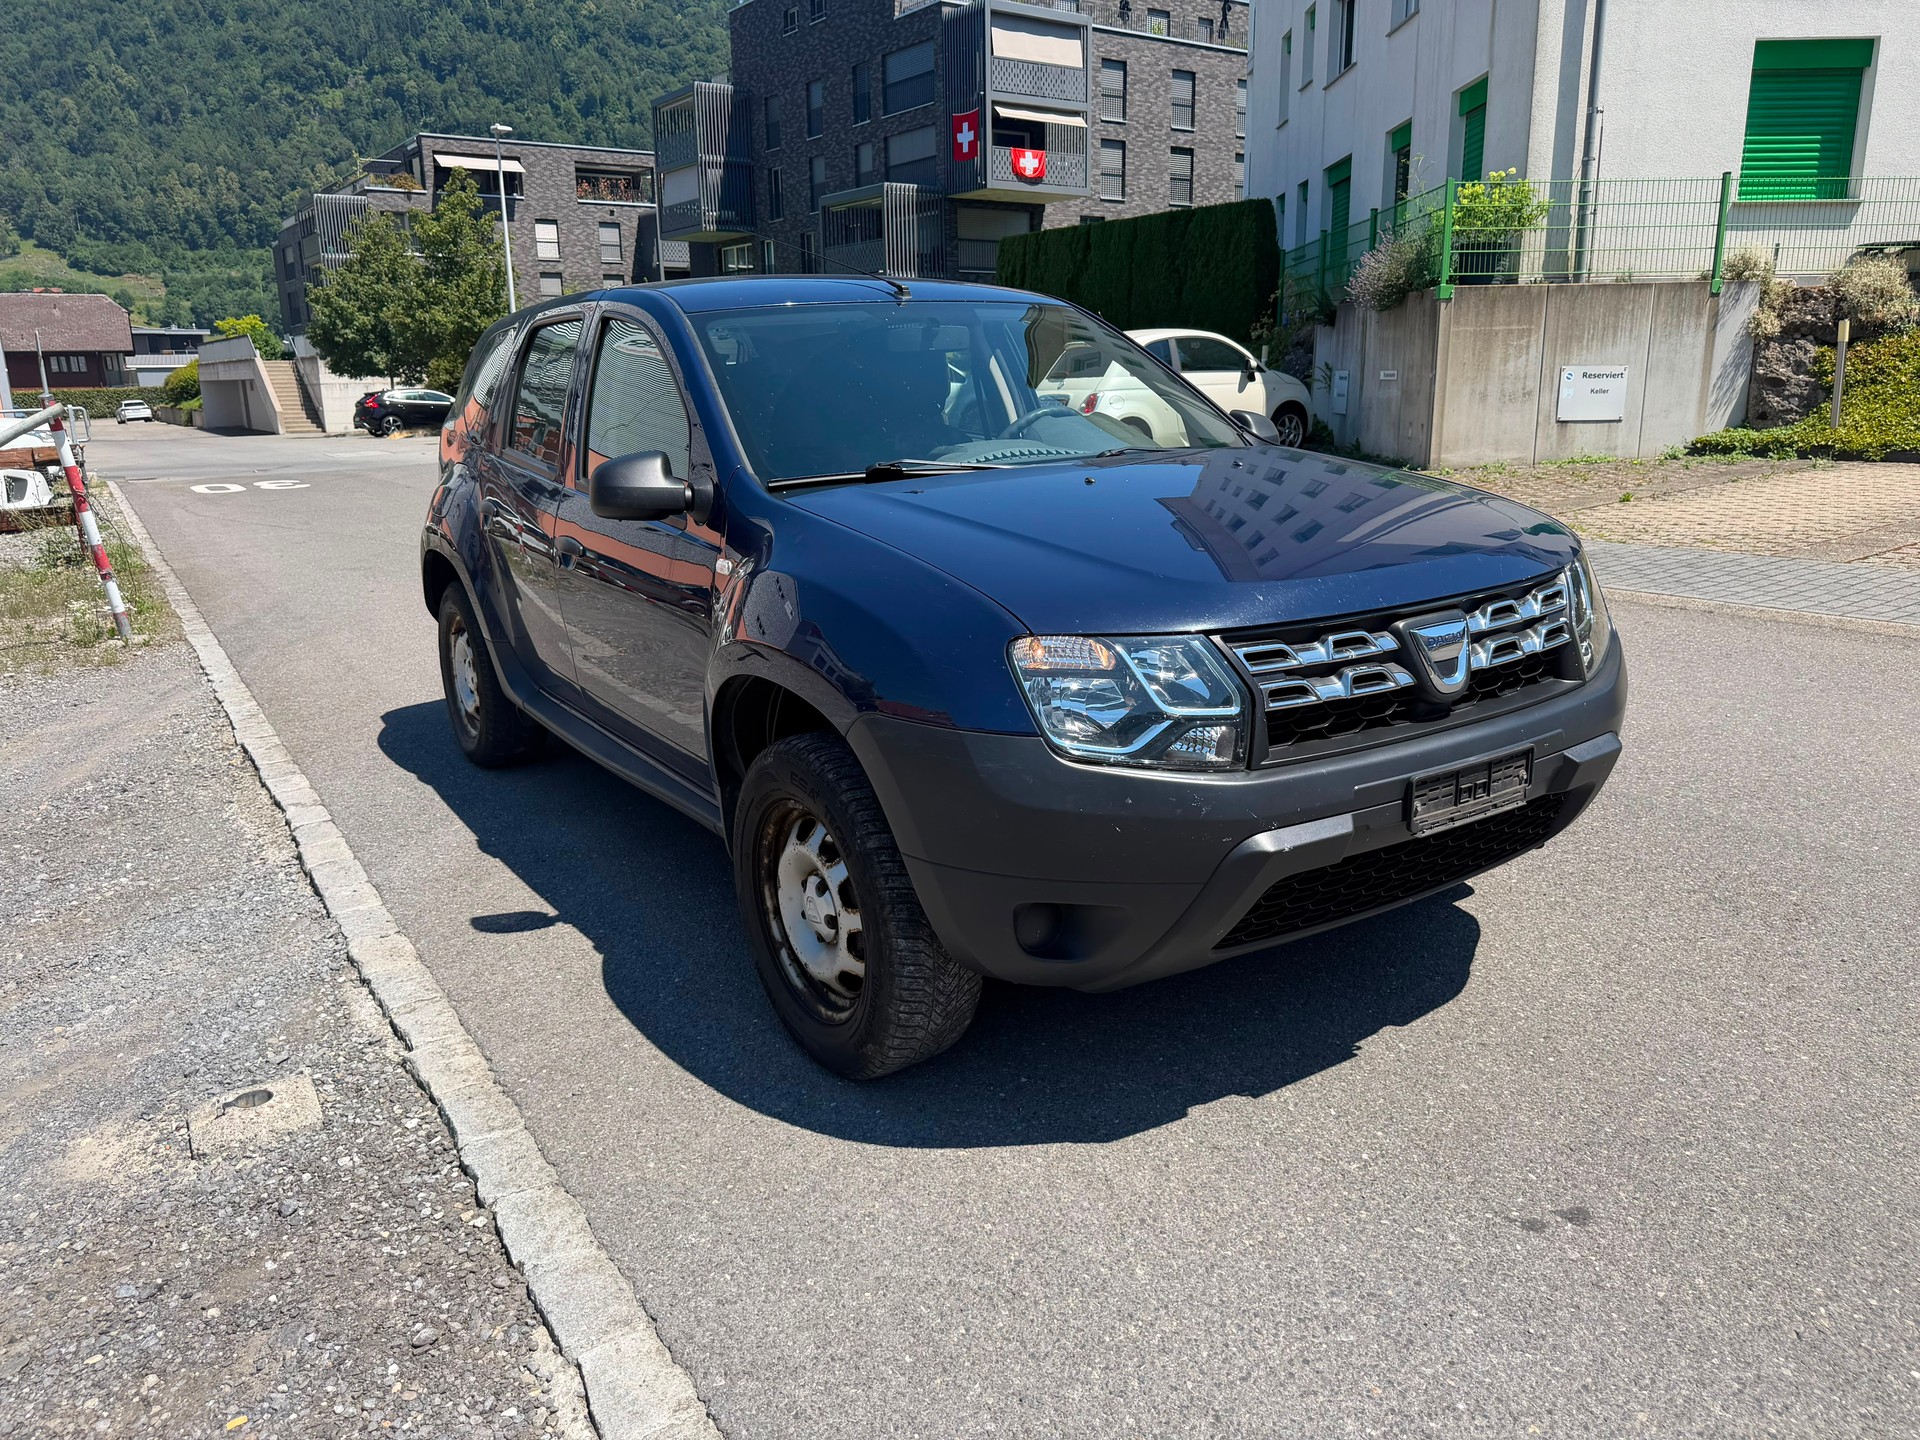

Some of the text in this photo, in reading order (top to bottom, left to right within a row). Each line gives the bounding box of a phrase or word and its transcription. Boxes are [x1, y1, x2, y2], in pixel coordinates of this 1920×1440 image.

[1582, 371, 1624, 380] Reserviert
[1590, 387, 1610, 395] Keller
[1427, 631, 1463, 648] DACIA
